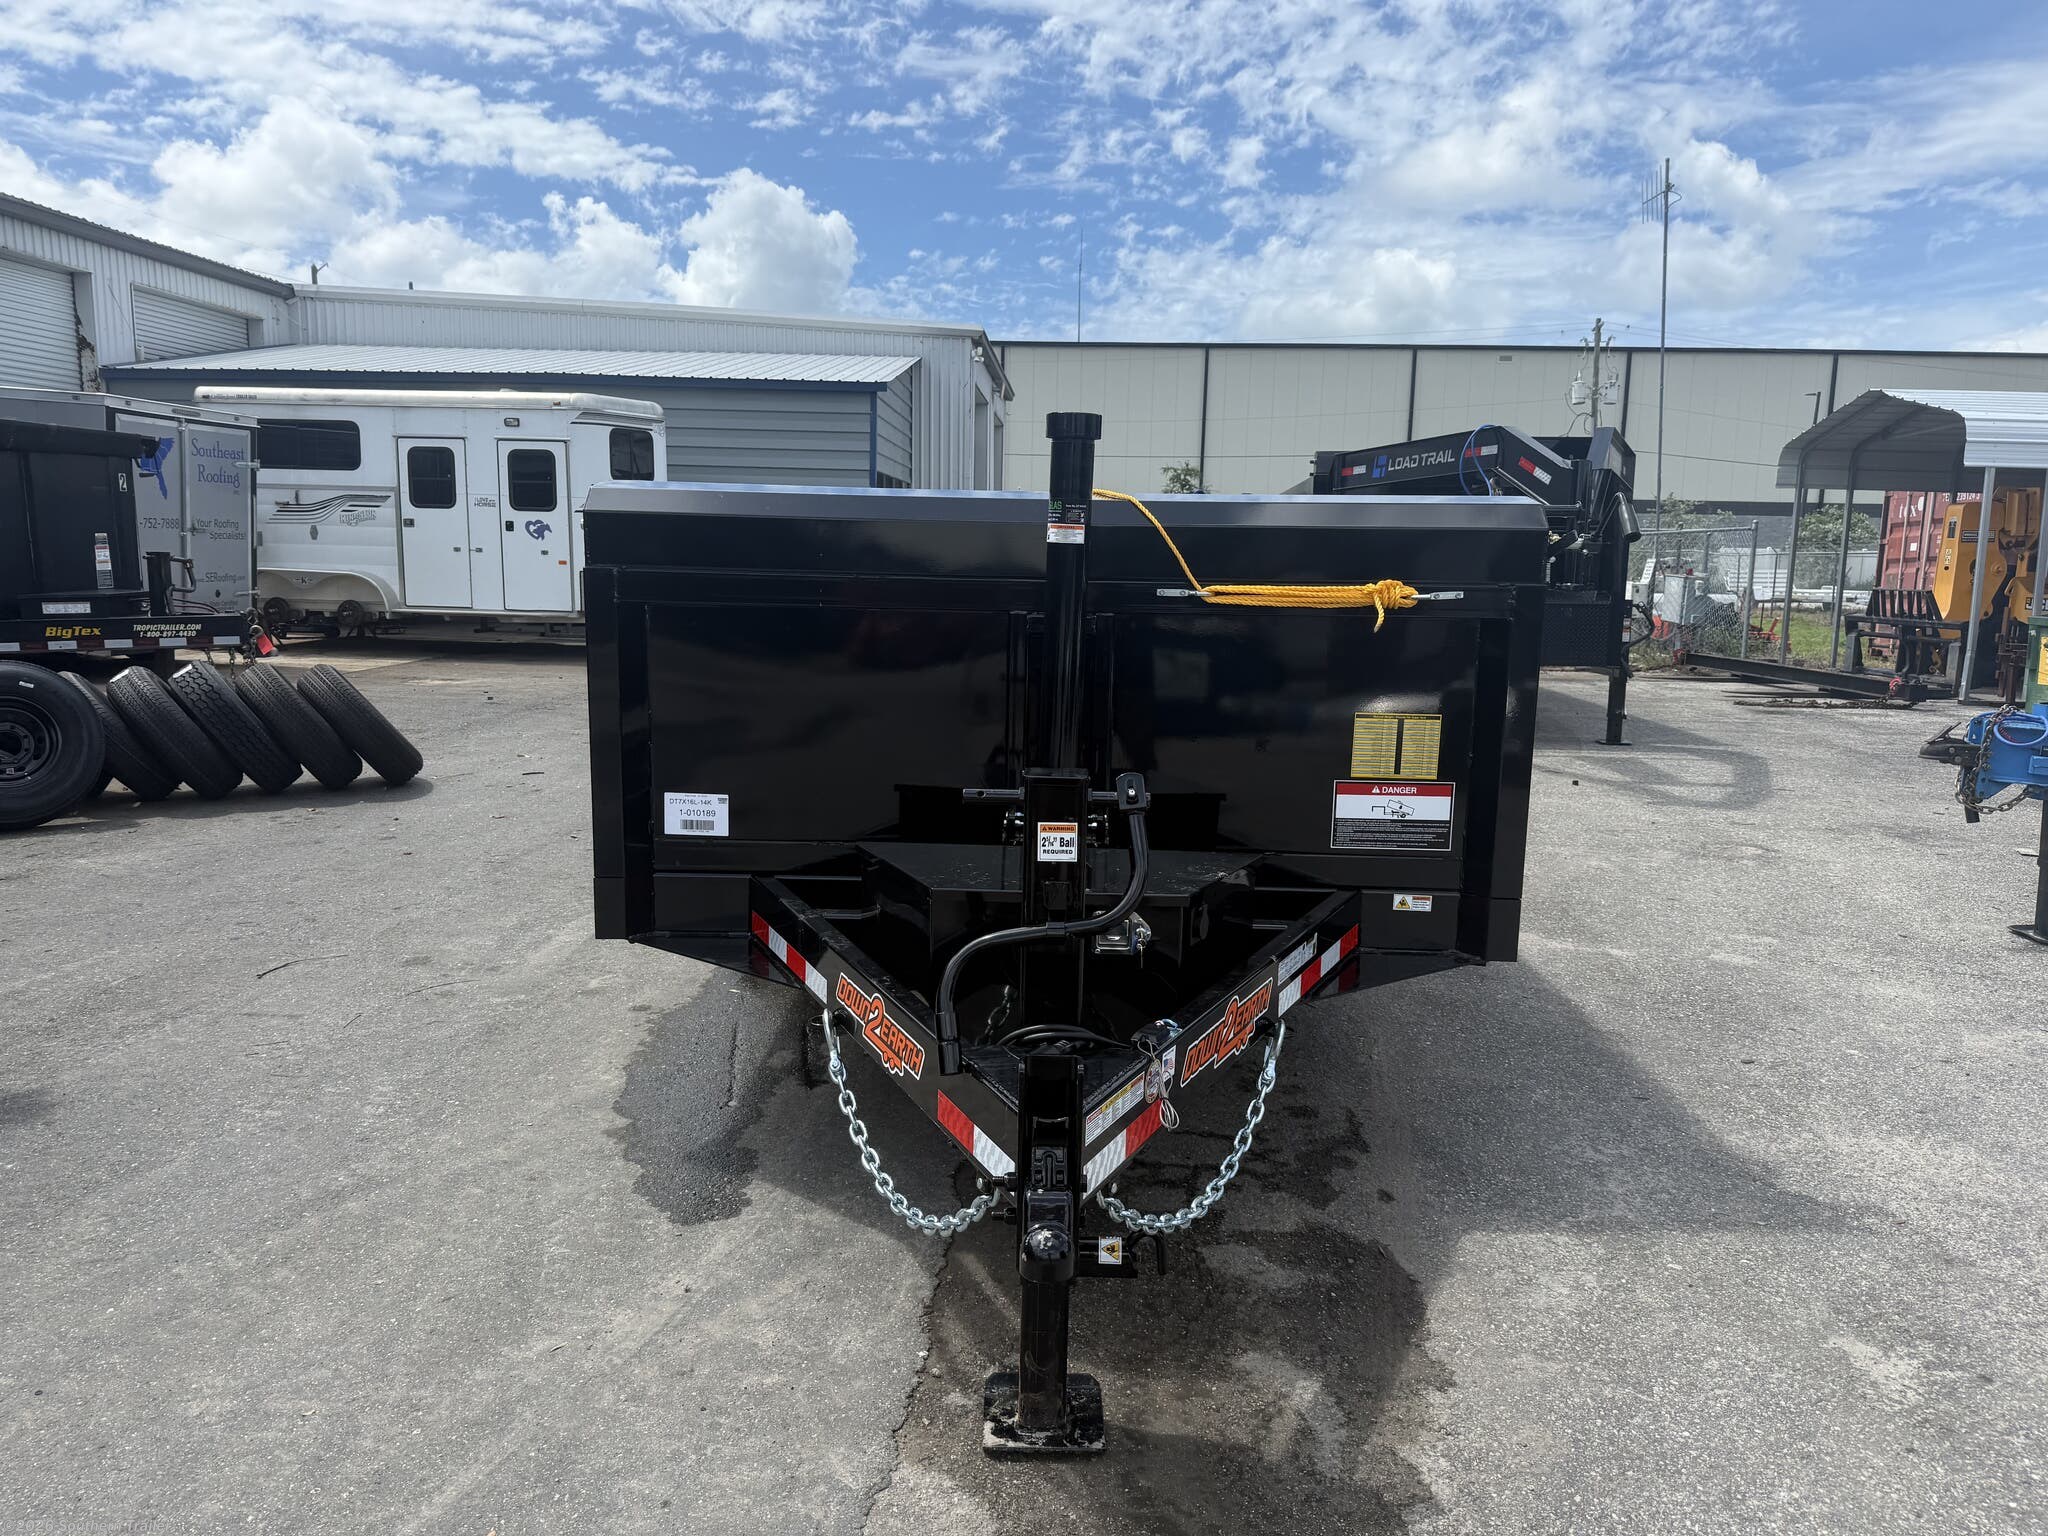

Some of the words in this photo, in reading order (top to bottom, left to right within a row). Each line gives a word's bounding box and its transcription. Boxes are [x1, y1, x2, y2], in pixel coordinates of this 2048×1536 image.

[191, 437, 244, 460] Southeast
[1388, 455, 1420, 471] LOAD
[1421, 449, 1455, 466] TRAIL
[120, 474, 127, 491] 2
[197, 464, 241, 488] Roofing
[196, 518, 213, 528] Your
[214, 518, 240, 531] Roofing
[45, 626, 102, 639] BigTex
[133, 623, 202, 632] TROPICTRAILER.COM
[1381, 786, 1417, 795] DANGER
[679, 808, 716, 818] 1-010189
[1059, 836, 1075, 848] Ball
